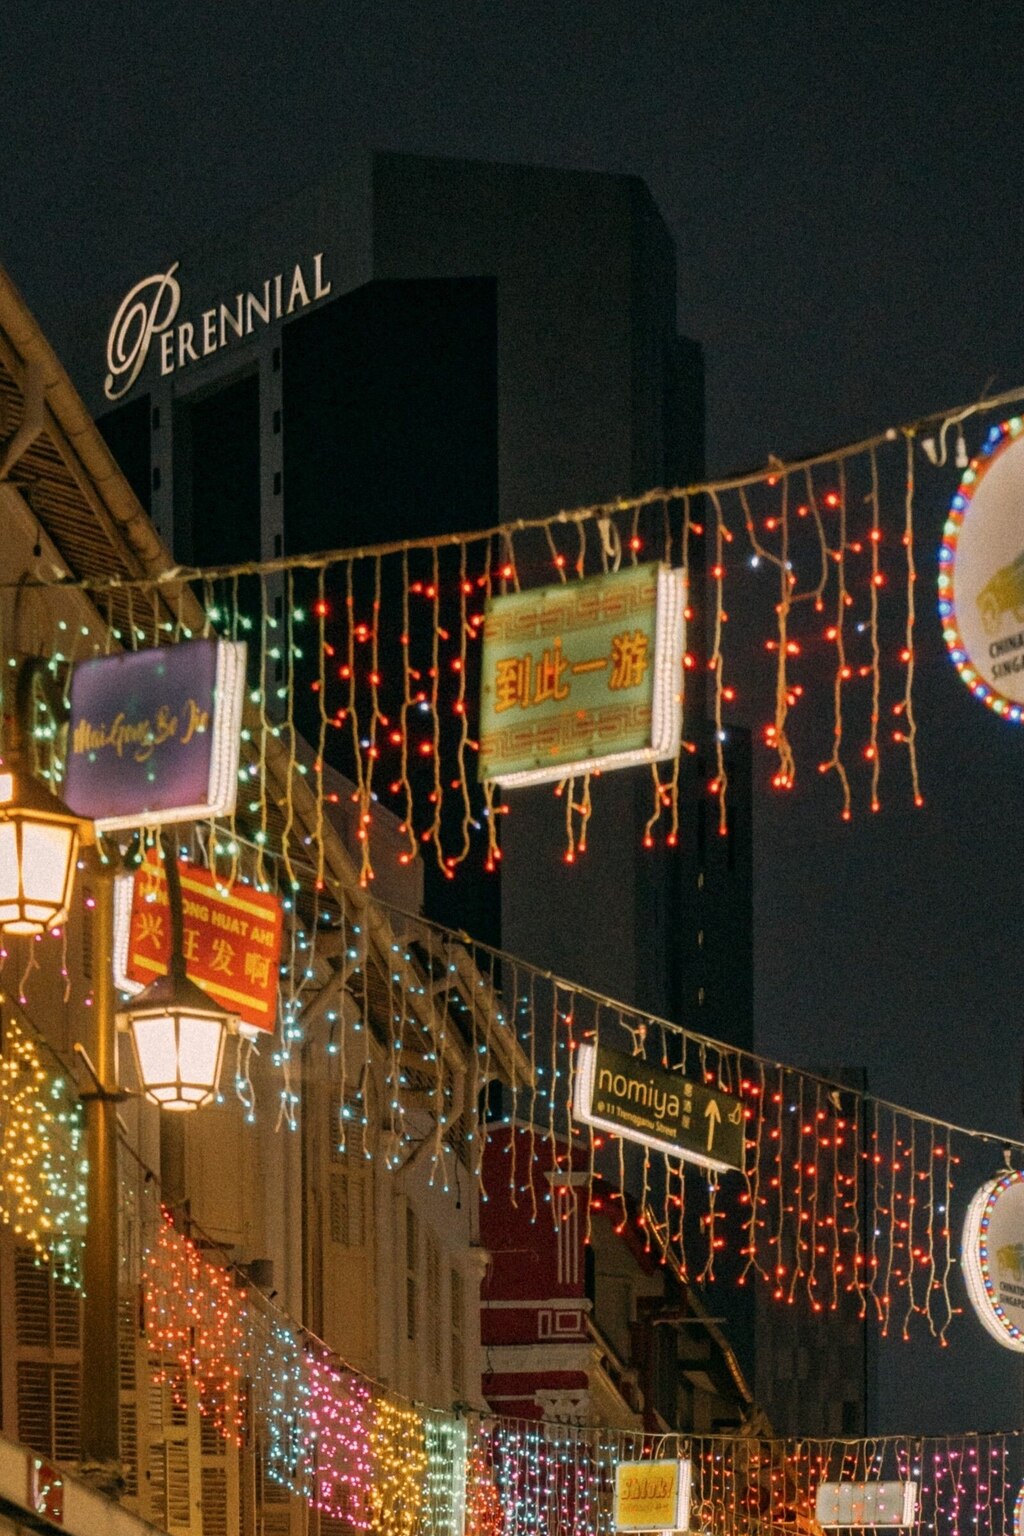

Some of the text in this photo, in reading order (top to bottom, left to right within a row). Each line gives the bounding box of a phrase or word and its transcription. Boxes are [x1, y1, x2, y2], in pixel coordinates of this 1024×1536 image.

[104, 253, 331, 400] PERENNIAL
[495, 629, 648, 713] 到此一游
[212, 911, 248, 936] HUAT
[598, 1069, 680, 1119] nomiya
